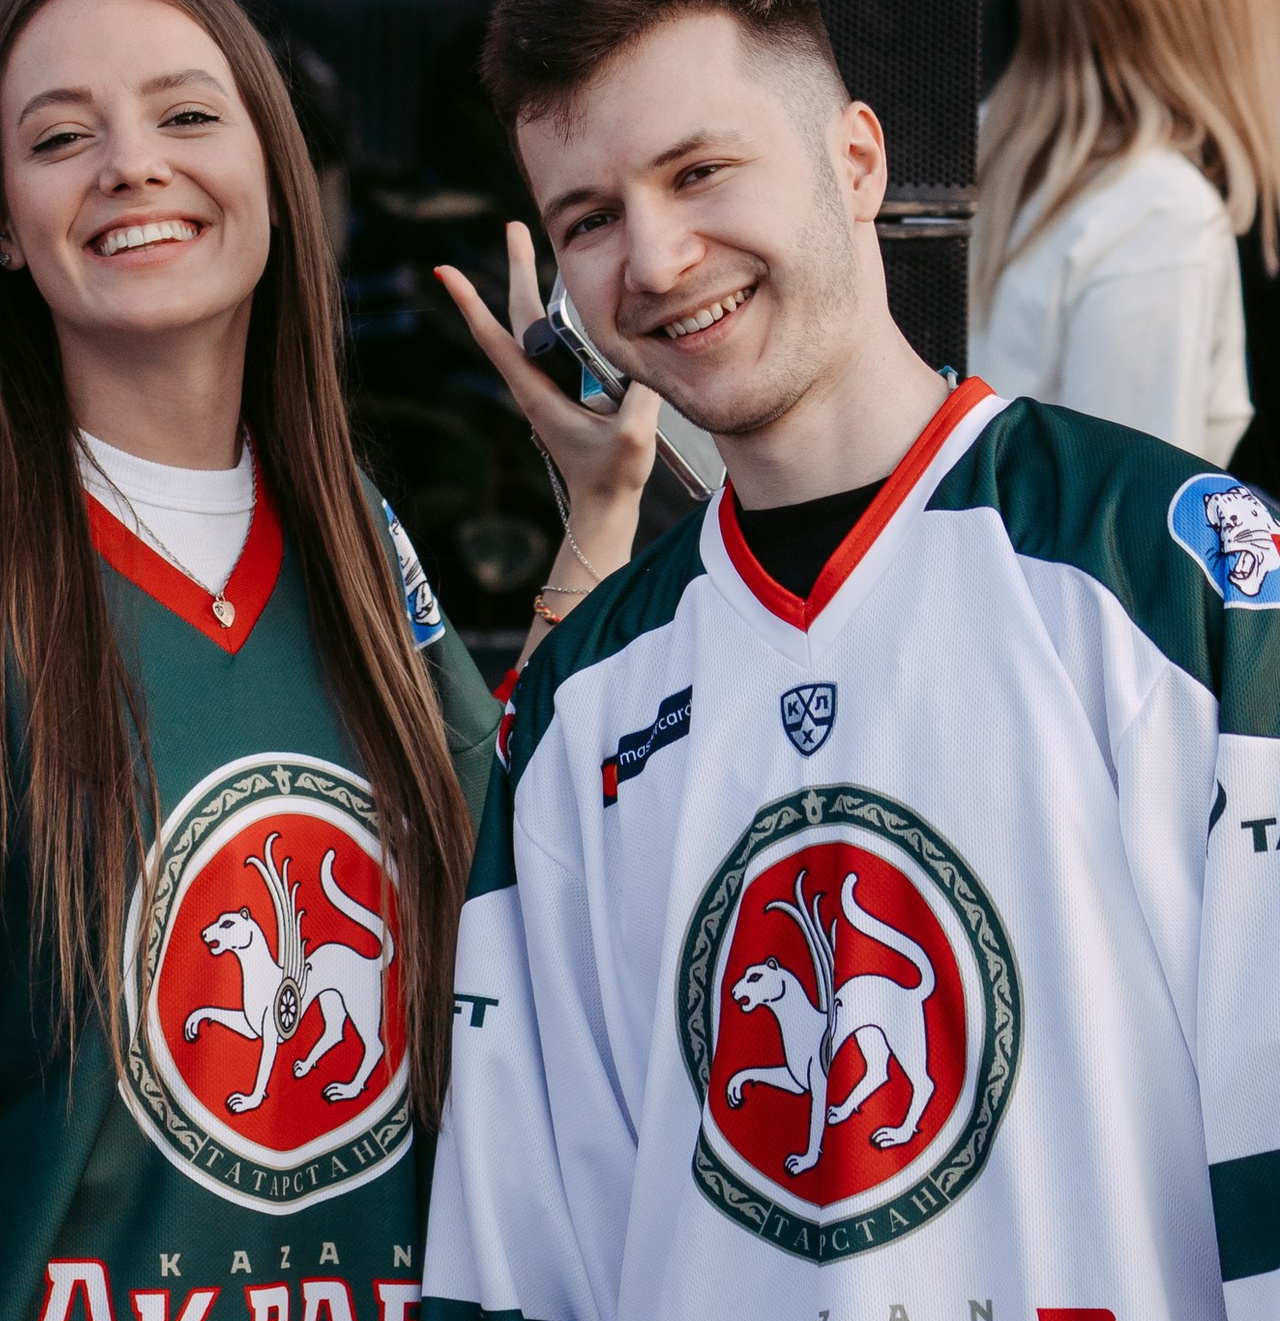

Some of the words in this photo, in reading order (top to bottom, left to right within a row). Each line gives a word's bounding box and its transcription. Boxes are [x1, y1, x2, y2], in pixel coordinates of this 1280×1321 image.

[619, 698, 693, 766] masrcard
[205, 1140, 377, 1196] ТАТАРСТАН
[774, 1186, 939, 1256] ТАРСТАН
[160, 1242, 412, 1277] KAZAN
